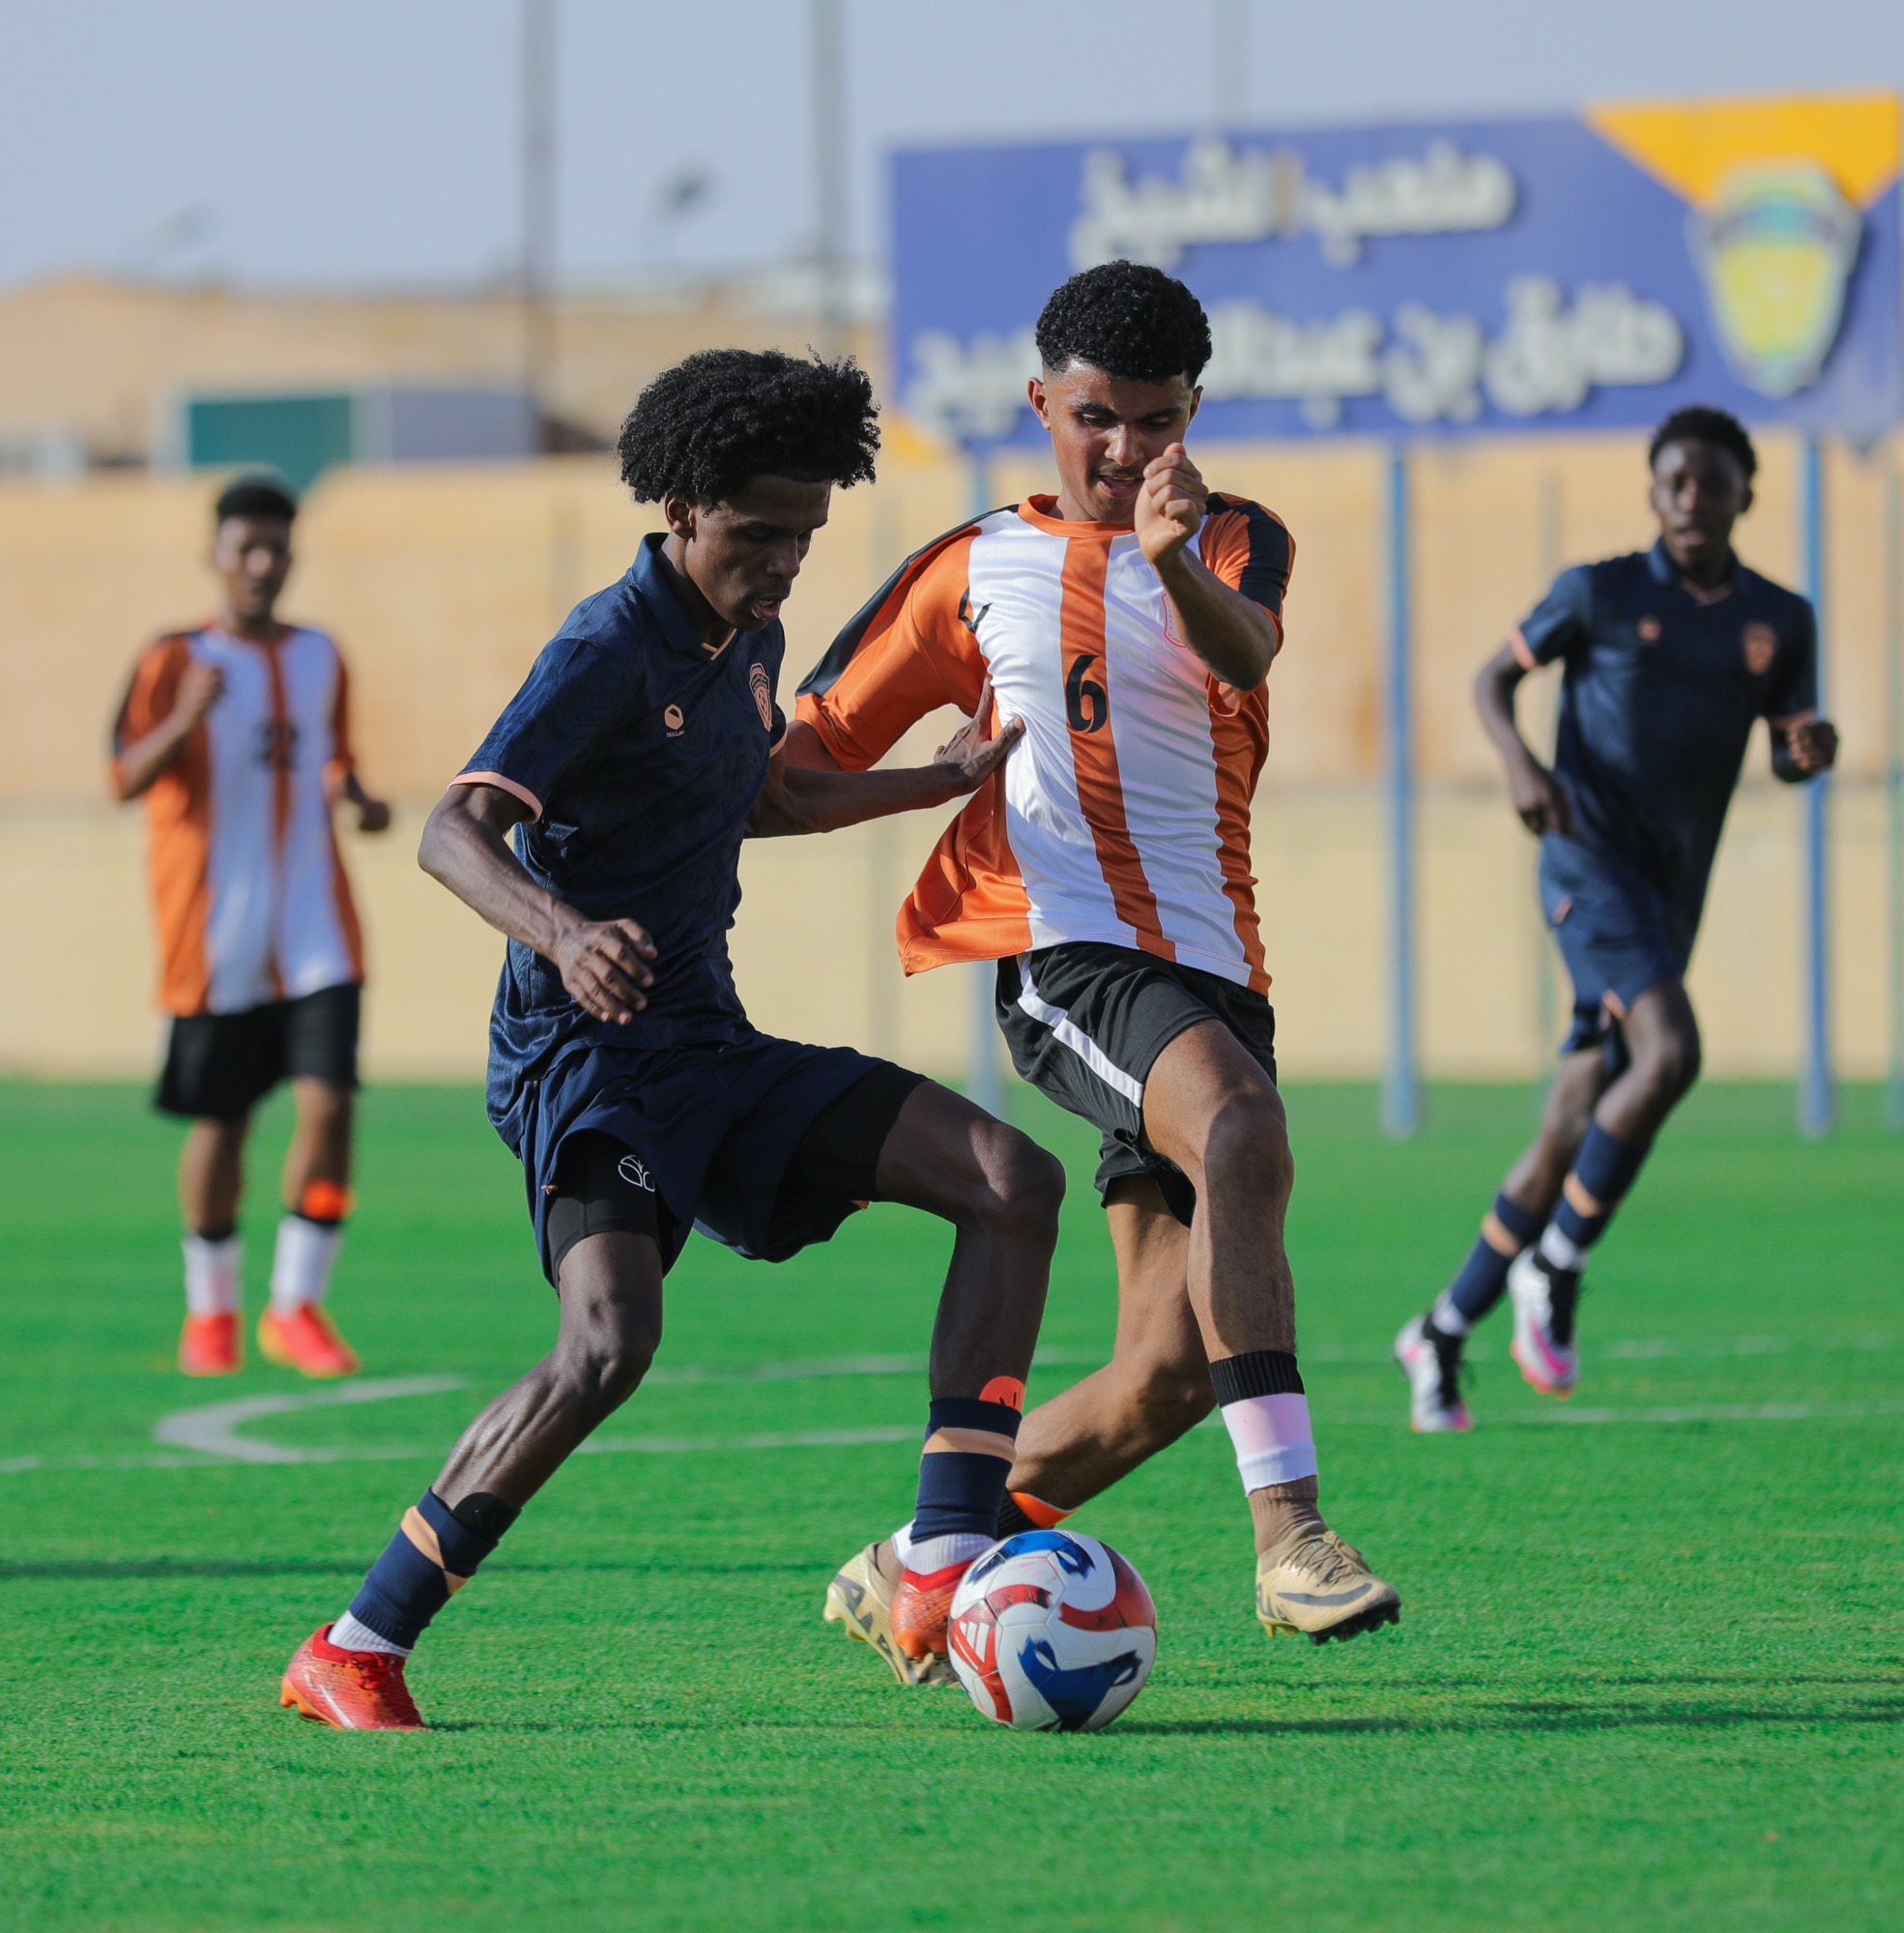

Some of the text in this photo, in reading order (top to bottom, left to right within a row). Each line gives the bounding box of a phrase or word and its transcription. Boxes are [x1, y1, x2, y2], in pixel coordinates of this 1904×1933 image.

[1075, 137, 1512, 271] ملعب الشيخ
[1389, 303, 1479, 421] بن
[1488, 276, 1680, 413] طارق
[1066, 654, 1108, 734] 6
